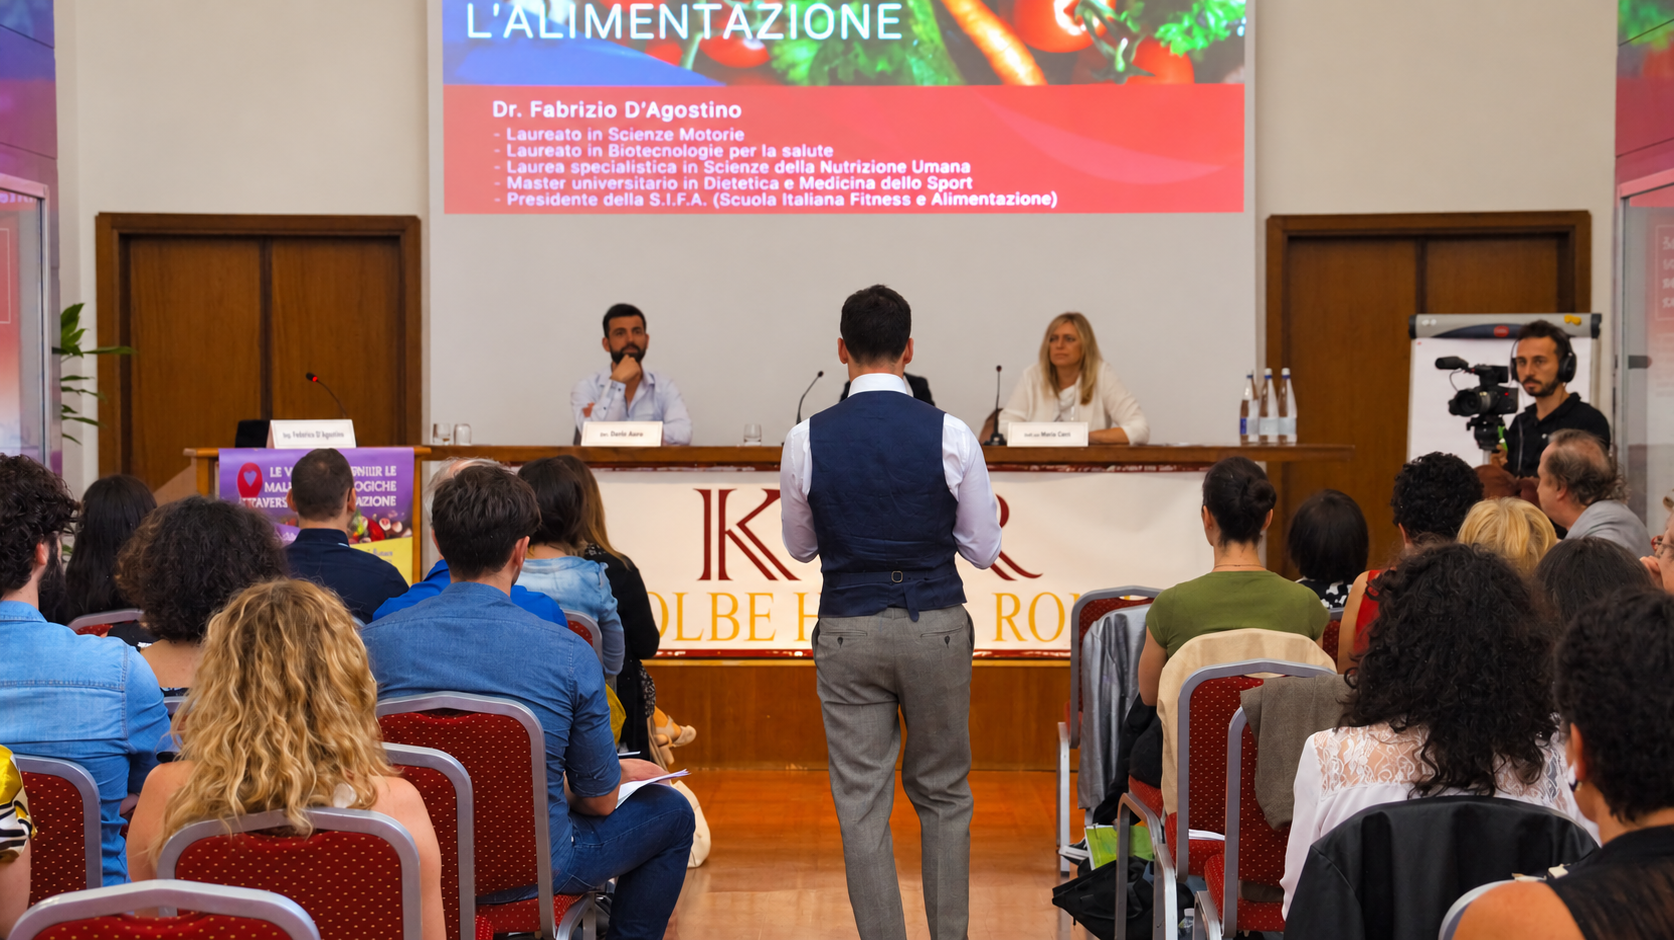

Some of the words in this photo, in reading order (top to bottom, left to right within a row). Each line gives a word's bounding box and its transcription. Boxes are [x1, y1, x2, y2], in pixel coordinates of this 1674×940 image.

[466, 2, 903, 40] L'ALIMENTAZIONE
[492, 101, 523, 118] Dr.
[530, 100, 617, 118] Fabrizio
[624, 100, 742, 121] D'Agostino
[506, 127, 582, 141] Laureato
[587, 127, 603, 141] in
[608, 127, 674, 141] Scienze
[679, 127, 745, 141] Motorie
[506, 143, 582, 158] Laureato
[587, 143, 603, 157] in
[608, 143, 724, 161] Biotecnologie
[729, 146, 757, 161] per
[761, 143, 777, 157] la
[781, 143, 834, 158] salute
[506, 160, 565, 174] Laurea
[570, 160, 677, 177] specialistica
[682, 160, 698, 174] in
[703, 159, 769, 174] Scienze
[774, 160, 816, 174] della
[820, 160, 907, 174] Nutrizione
[911, 160, 971, 174] Umana
[506, 176, 566, 190] Master
[571, 176, 679, 190] universitario
[683, 176, 699, 190] in
[703, 176, 780, 190] Dietetica
[783, 179, 795, 190] e
[799, 176, 876, 190] Medicina
[880, 176, 922, 190] dello
[926, 176, 973, 193] Sport
[507, 192, 598, 207] Presidente
[603, 192, 644, 207] della
[649, 192, 708, 207] S.I.F.A.
[712, 192, 777, 208] (Scuola
[782, 192, 845, 207] Italiana
[850, 192, 912, 207] Fitness
[915, 195, 927, 207] e
[930, 191, 1058, 208] Alimentazione)
[270, 466, 282, 478] LE
[384, 465, 397, 477] LE
